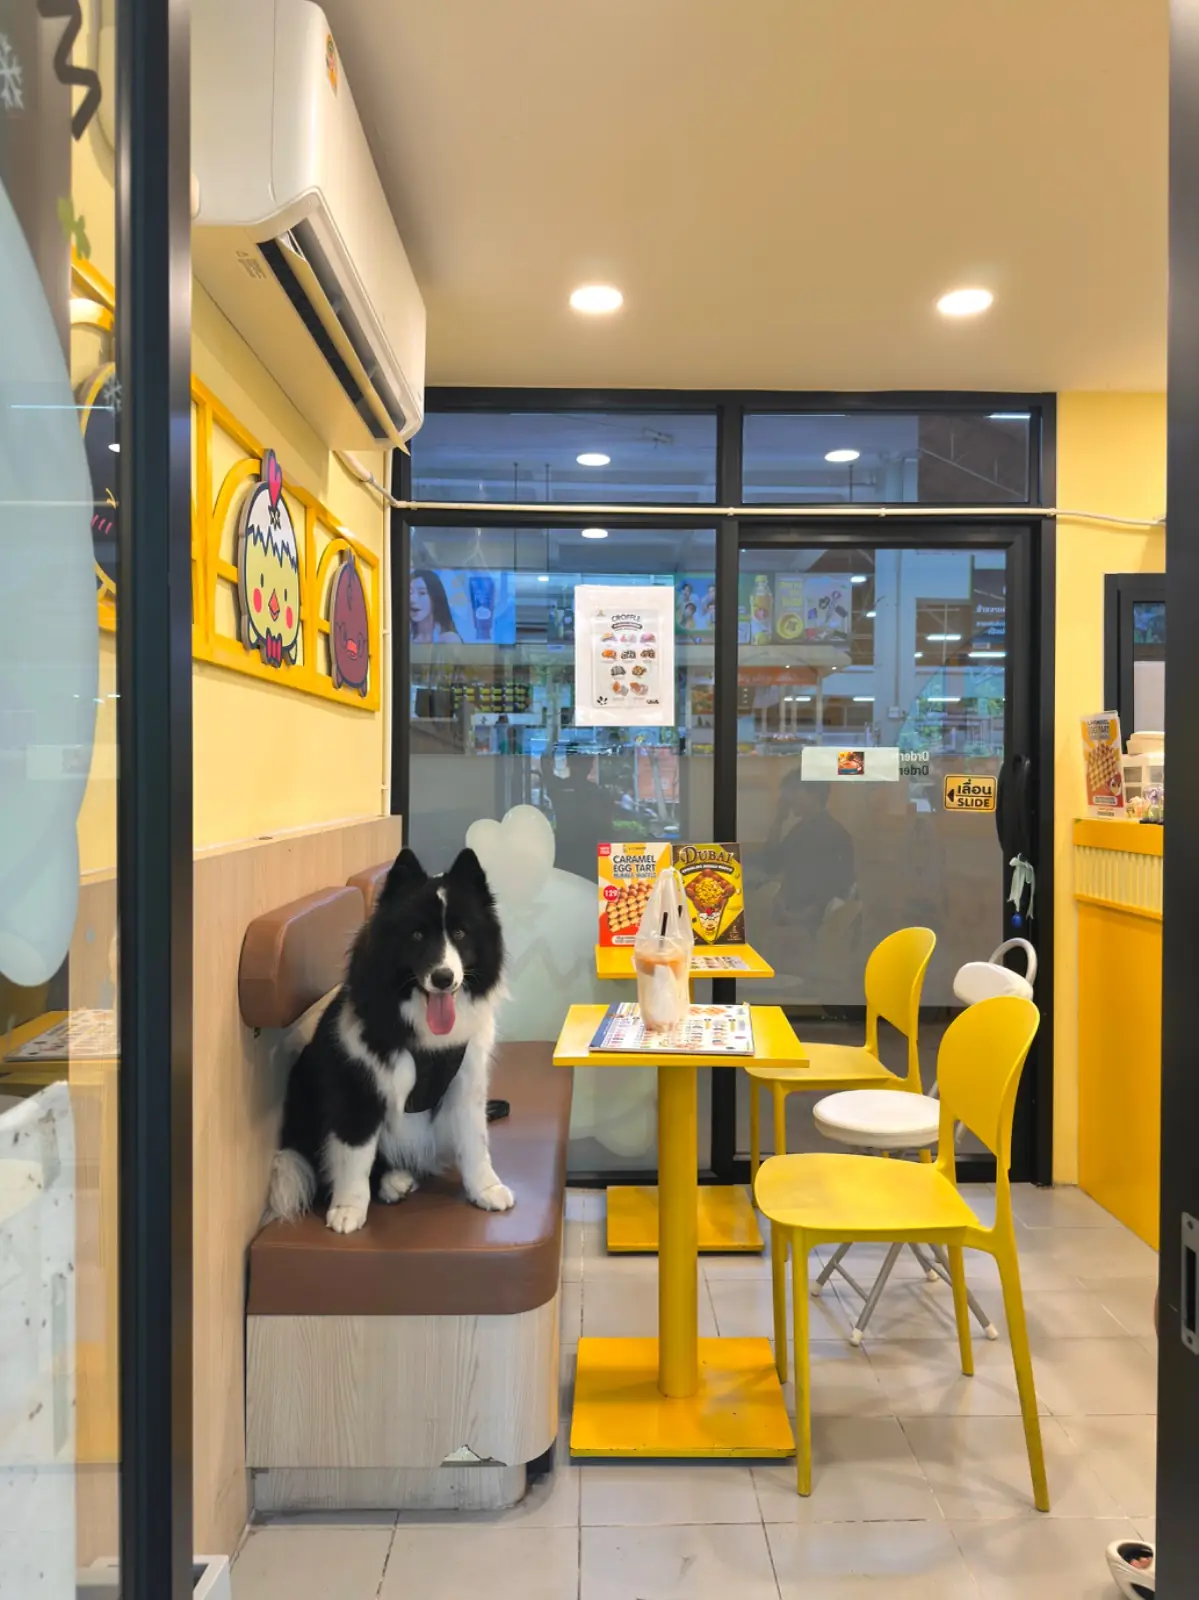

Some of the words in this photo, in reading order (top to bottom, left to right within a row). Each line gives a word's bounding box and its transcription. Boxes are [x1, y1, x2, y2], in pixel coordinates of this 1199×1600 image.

[958, 777, 992, 795] เลื่อน
[958, 798, 990, 807] SLIDE
[613, 855, 657, 864] CARAMEL
[613, 864, 632, 872] EGG
[635, 864, 656, 872] TART
